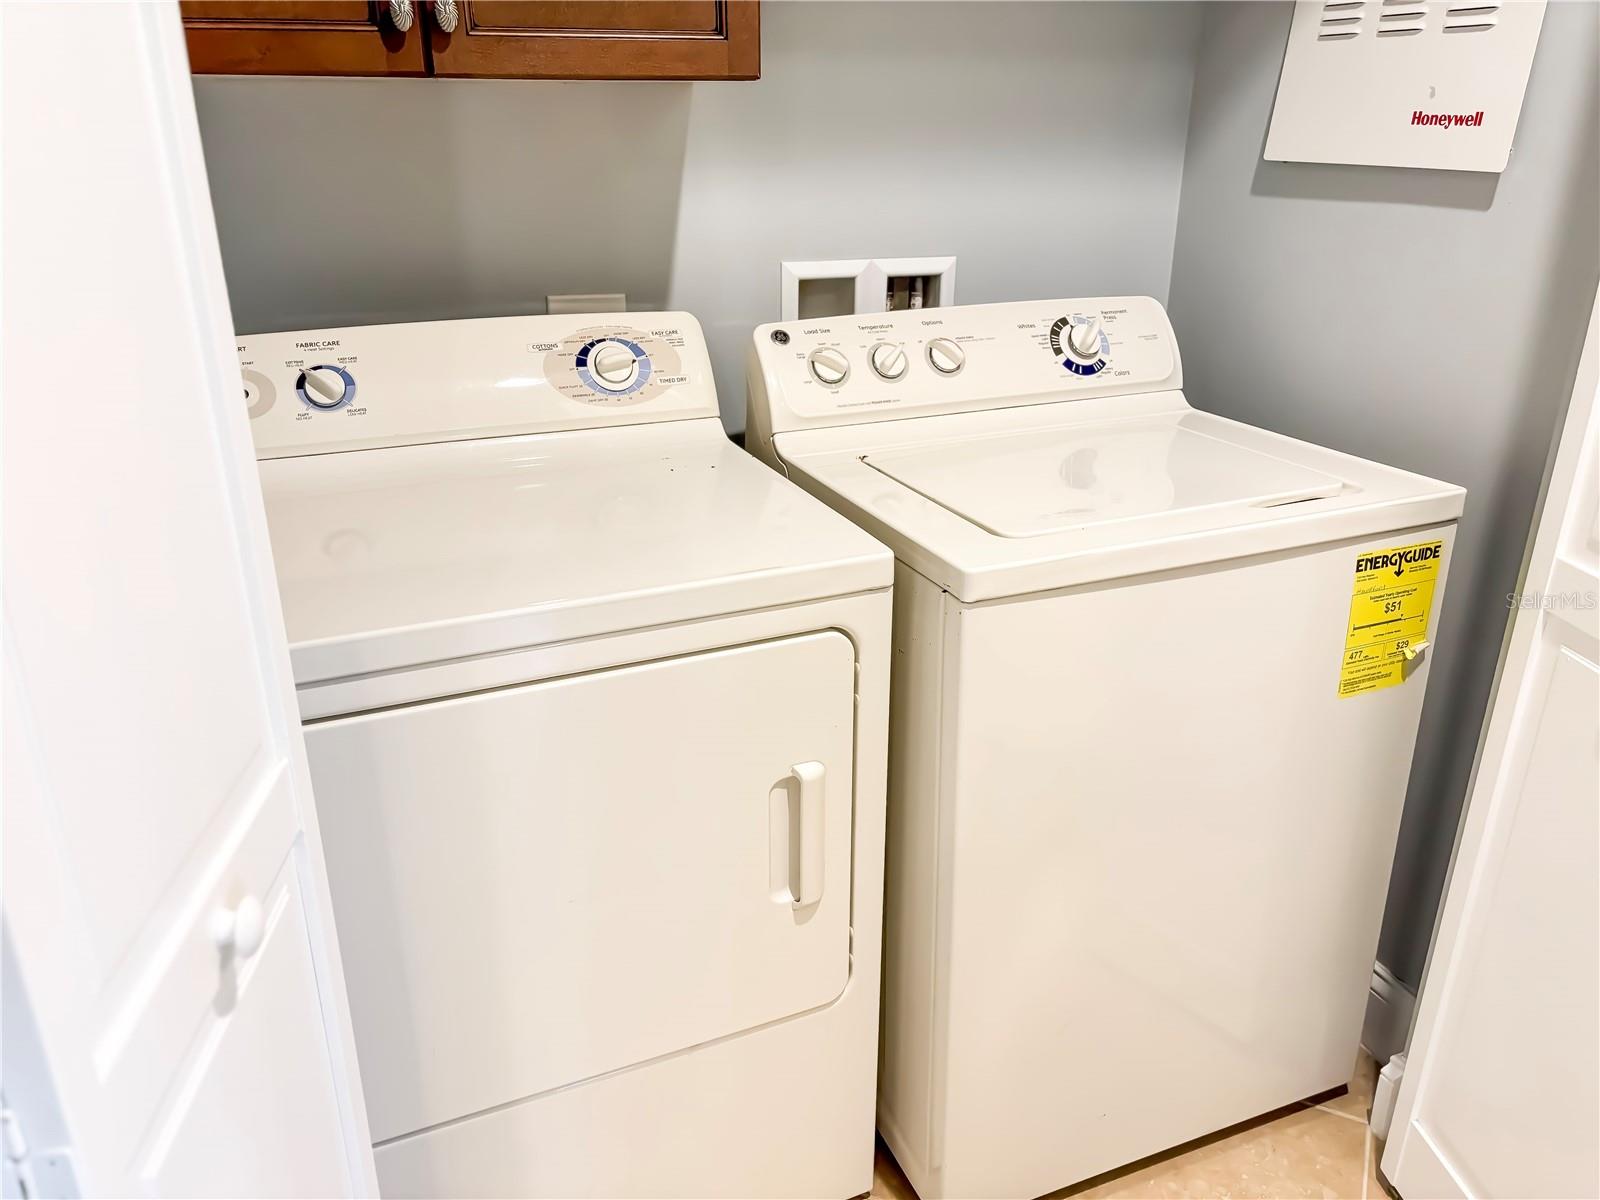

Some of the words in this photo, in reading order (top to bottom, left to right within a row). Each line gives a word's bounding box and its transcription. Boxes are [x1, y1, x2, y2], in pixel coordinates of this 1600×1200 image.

[1410, 110, 1484, 130] Honeywell
[295, 341, 320, 349] FABRIC
[1355, 544, 1442, 574] ENERGYGUIDE
[1384, 600, 1402, 614] $51
[1395, 640, 1409, 650] $29
[1349, 650, 1363, 660] 477
